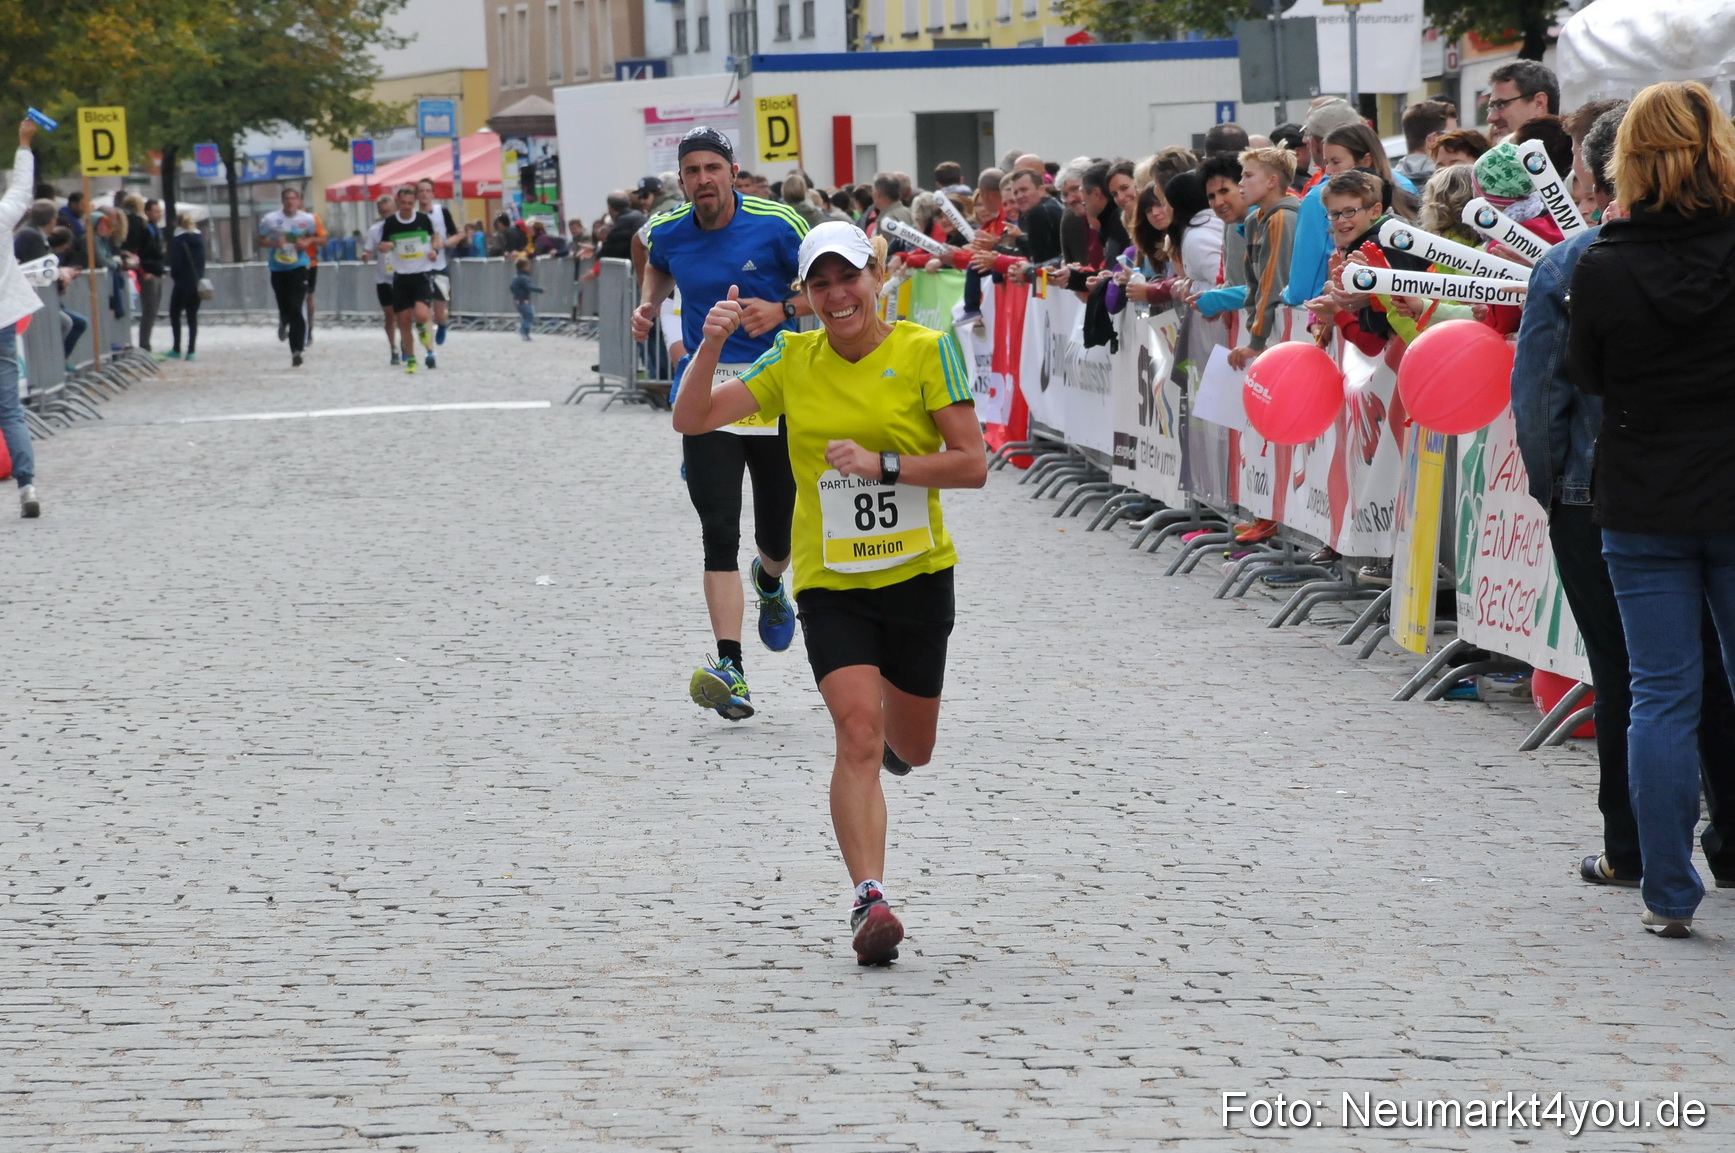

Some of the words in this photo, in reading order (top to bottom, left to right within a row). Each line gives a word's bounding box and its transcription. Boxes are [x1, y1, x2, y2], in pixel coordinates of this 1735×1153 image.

[759, 97, 794, 112] Block
[84, 111, 120, 123] Block
[767, 116, 790, 147] D
[92, 129, 115, 160] D
[1540, 181, 1580, 231] BMW
[820, 479, 855, 490] PARTL
[857, 478, 882, 488] Neu
[854, 491, 898, 531] 85
[852, 540, 903, 558] Marion
